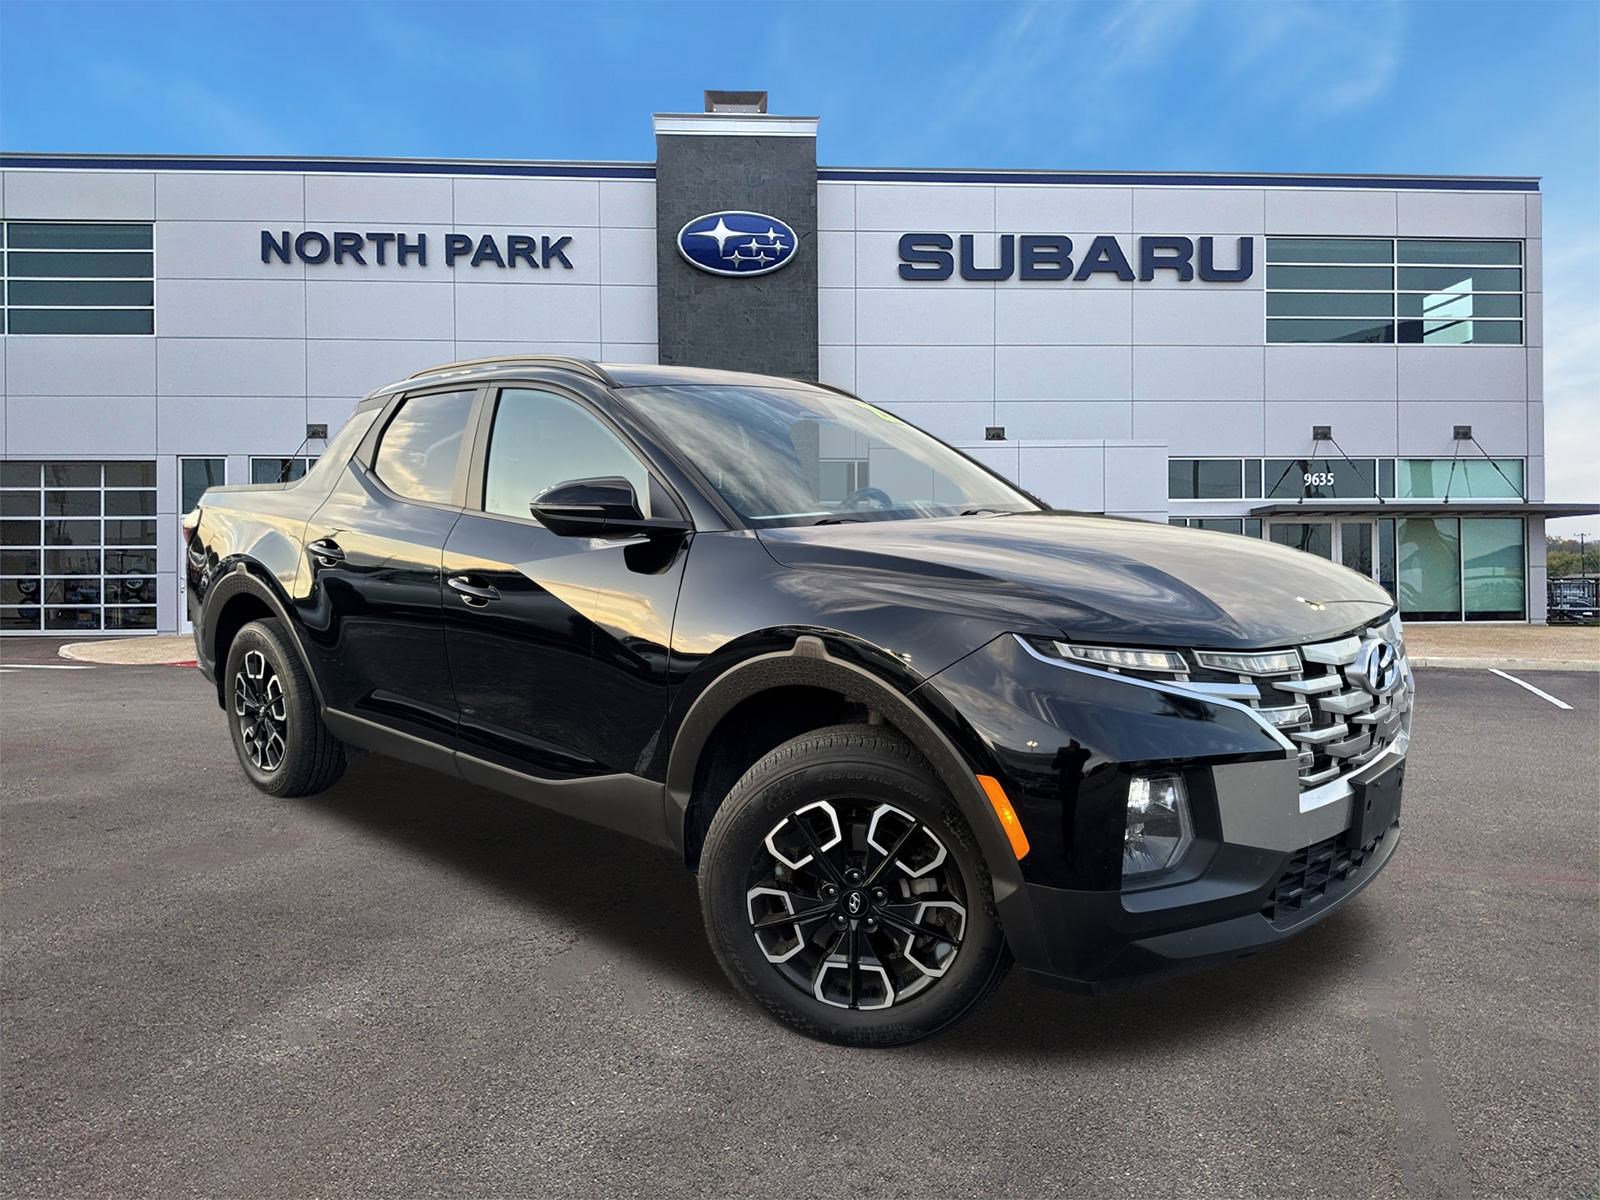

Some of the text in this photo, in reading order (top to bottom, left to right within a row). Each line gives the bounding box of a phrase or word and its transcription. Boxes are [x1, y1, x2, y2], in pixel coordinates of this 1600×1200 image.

[260, 230, 573, 270] NORTH PARK
[898, 232, 1254, 283] SUBARU
[1303, 472, 1335, 486] 9635
